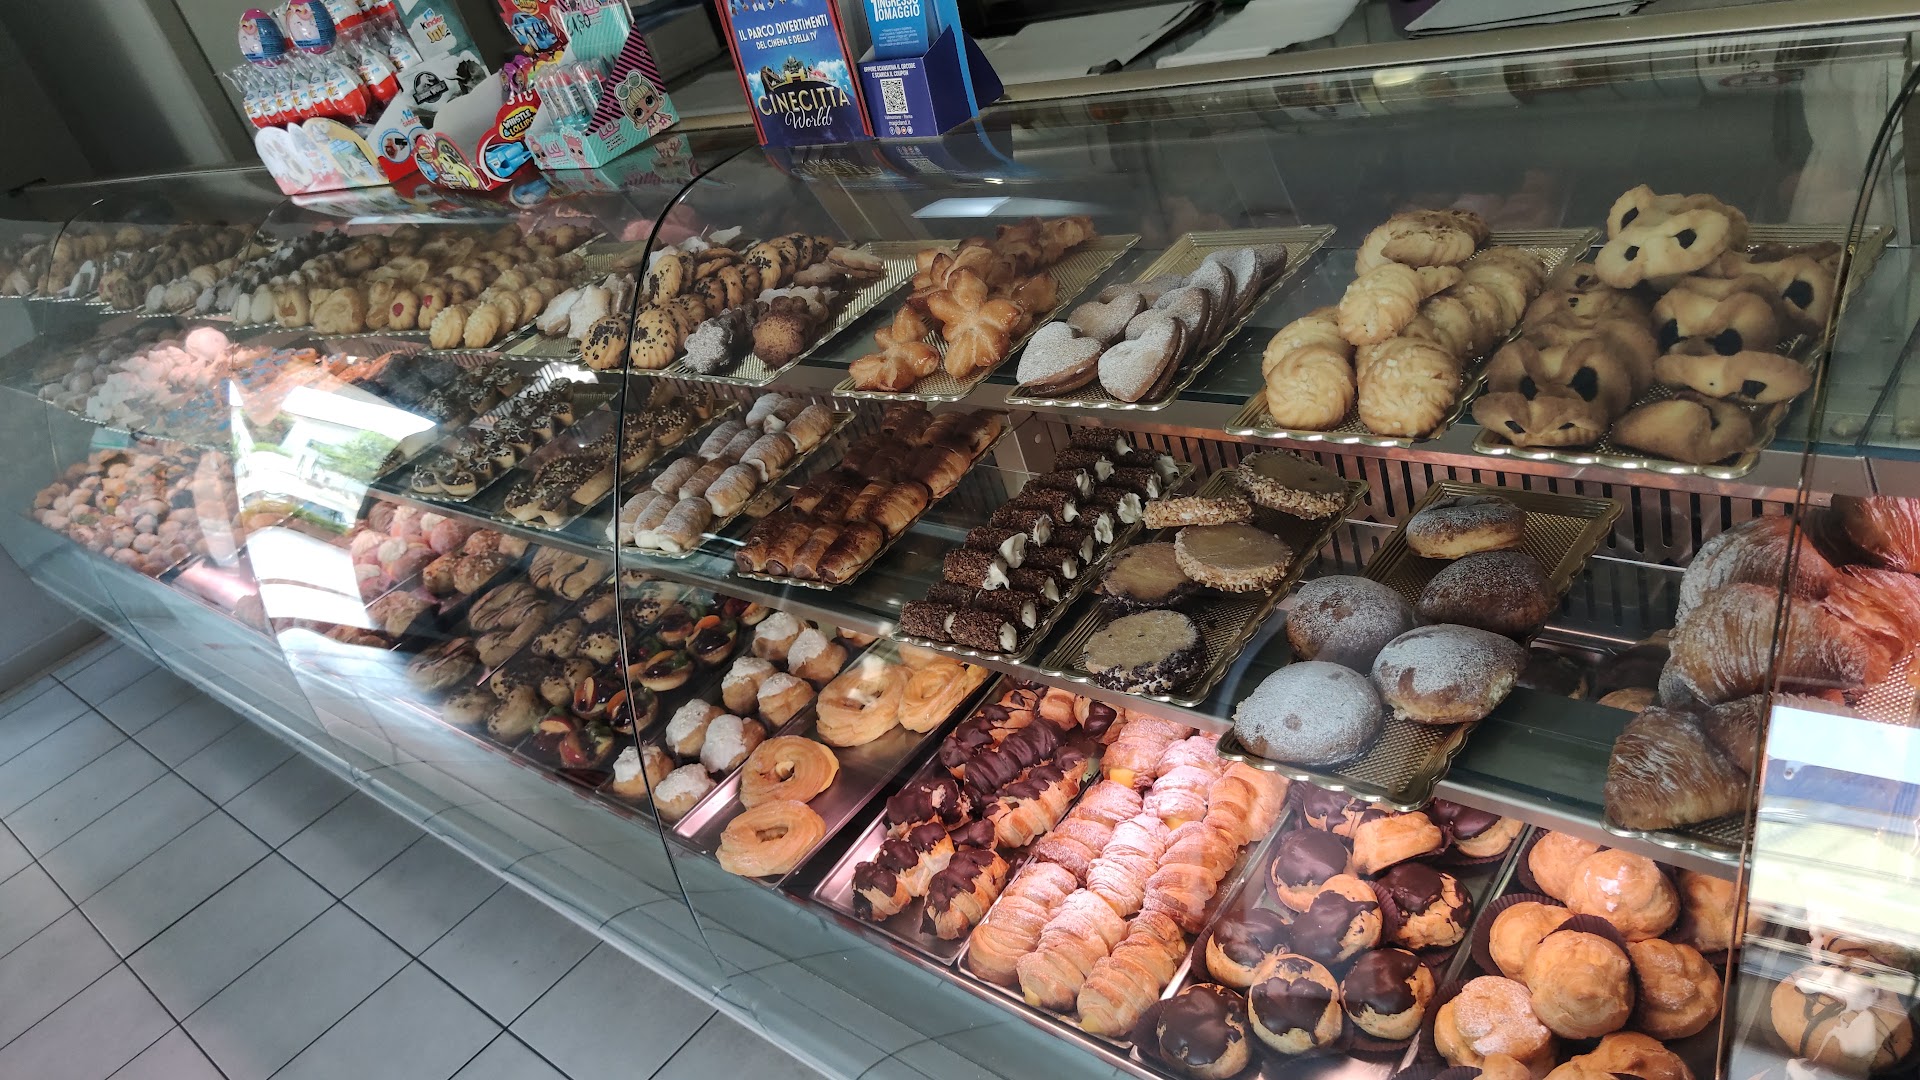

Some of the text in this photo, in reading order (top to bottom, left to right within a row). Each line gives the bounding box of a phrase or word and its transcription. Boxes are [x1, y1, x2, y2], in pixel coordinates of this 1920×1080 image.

[878, 4, 920, 21] OMAGGIO
[738, 14, 829, 41] IL PARCO DIVERTIMENTI
[756, 40, 767, 50] DEL
[768, 38, 788, 49] CINEMA
[793, 33, 810, 43] DELLA
[809, 31, 817, 40] TV
[503, 109, 532, 129] WHISTLE
[509, 116, 535, 135] LOLLIPO
[784, 105, 833, 129] World
